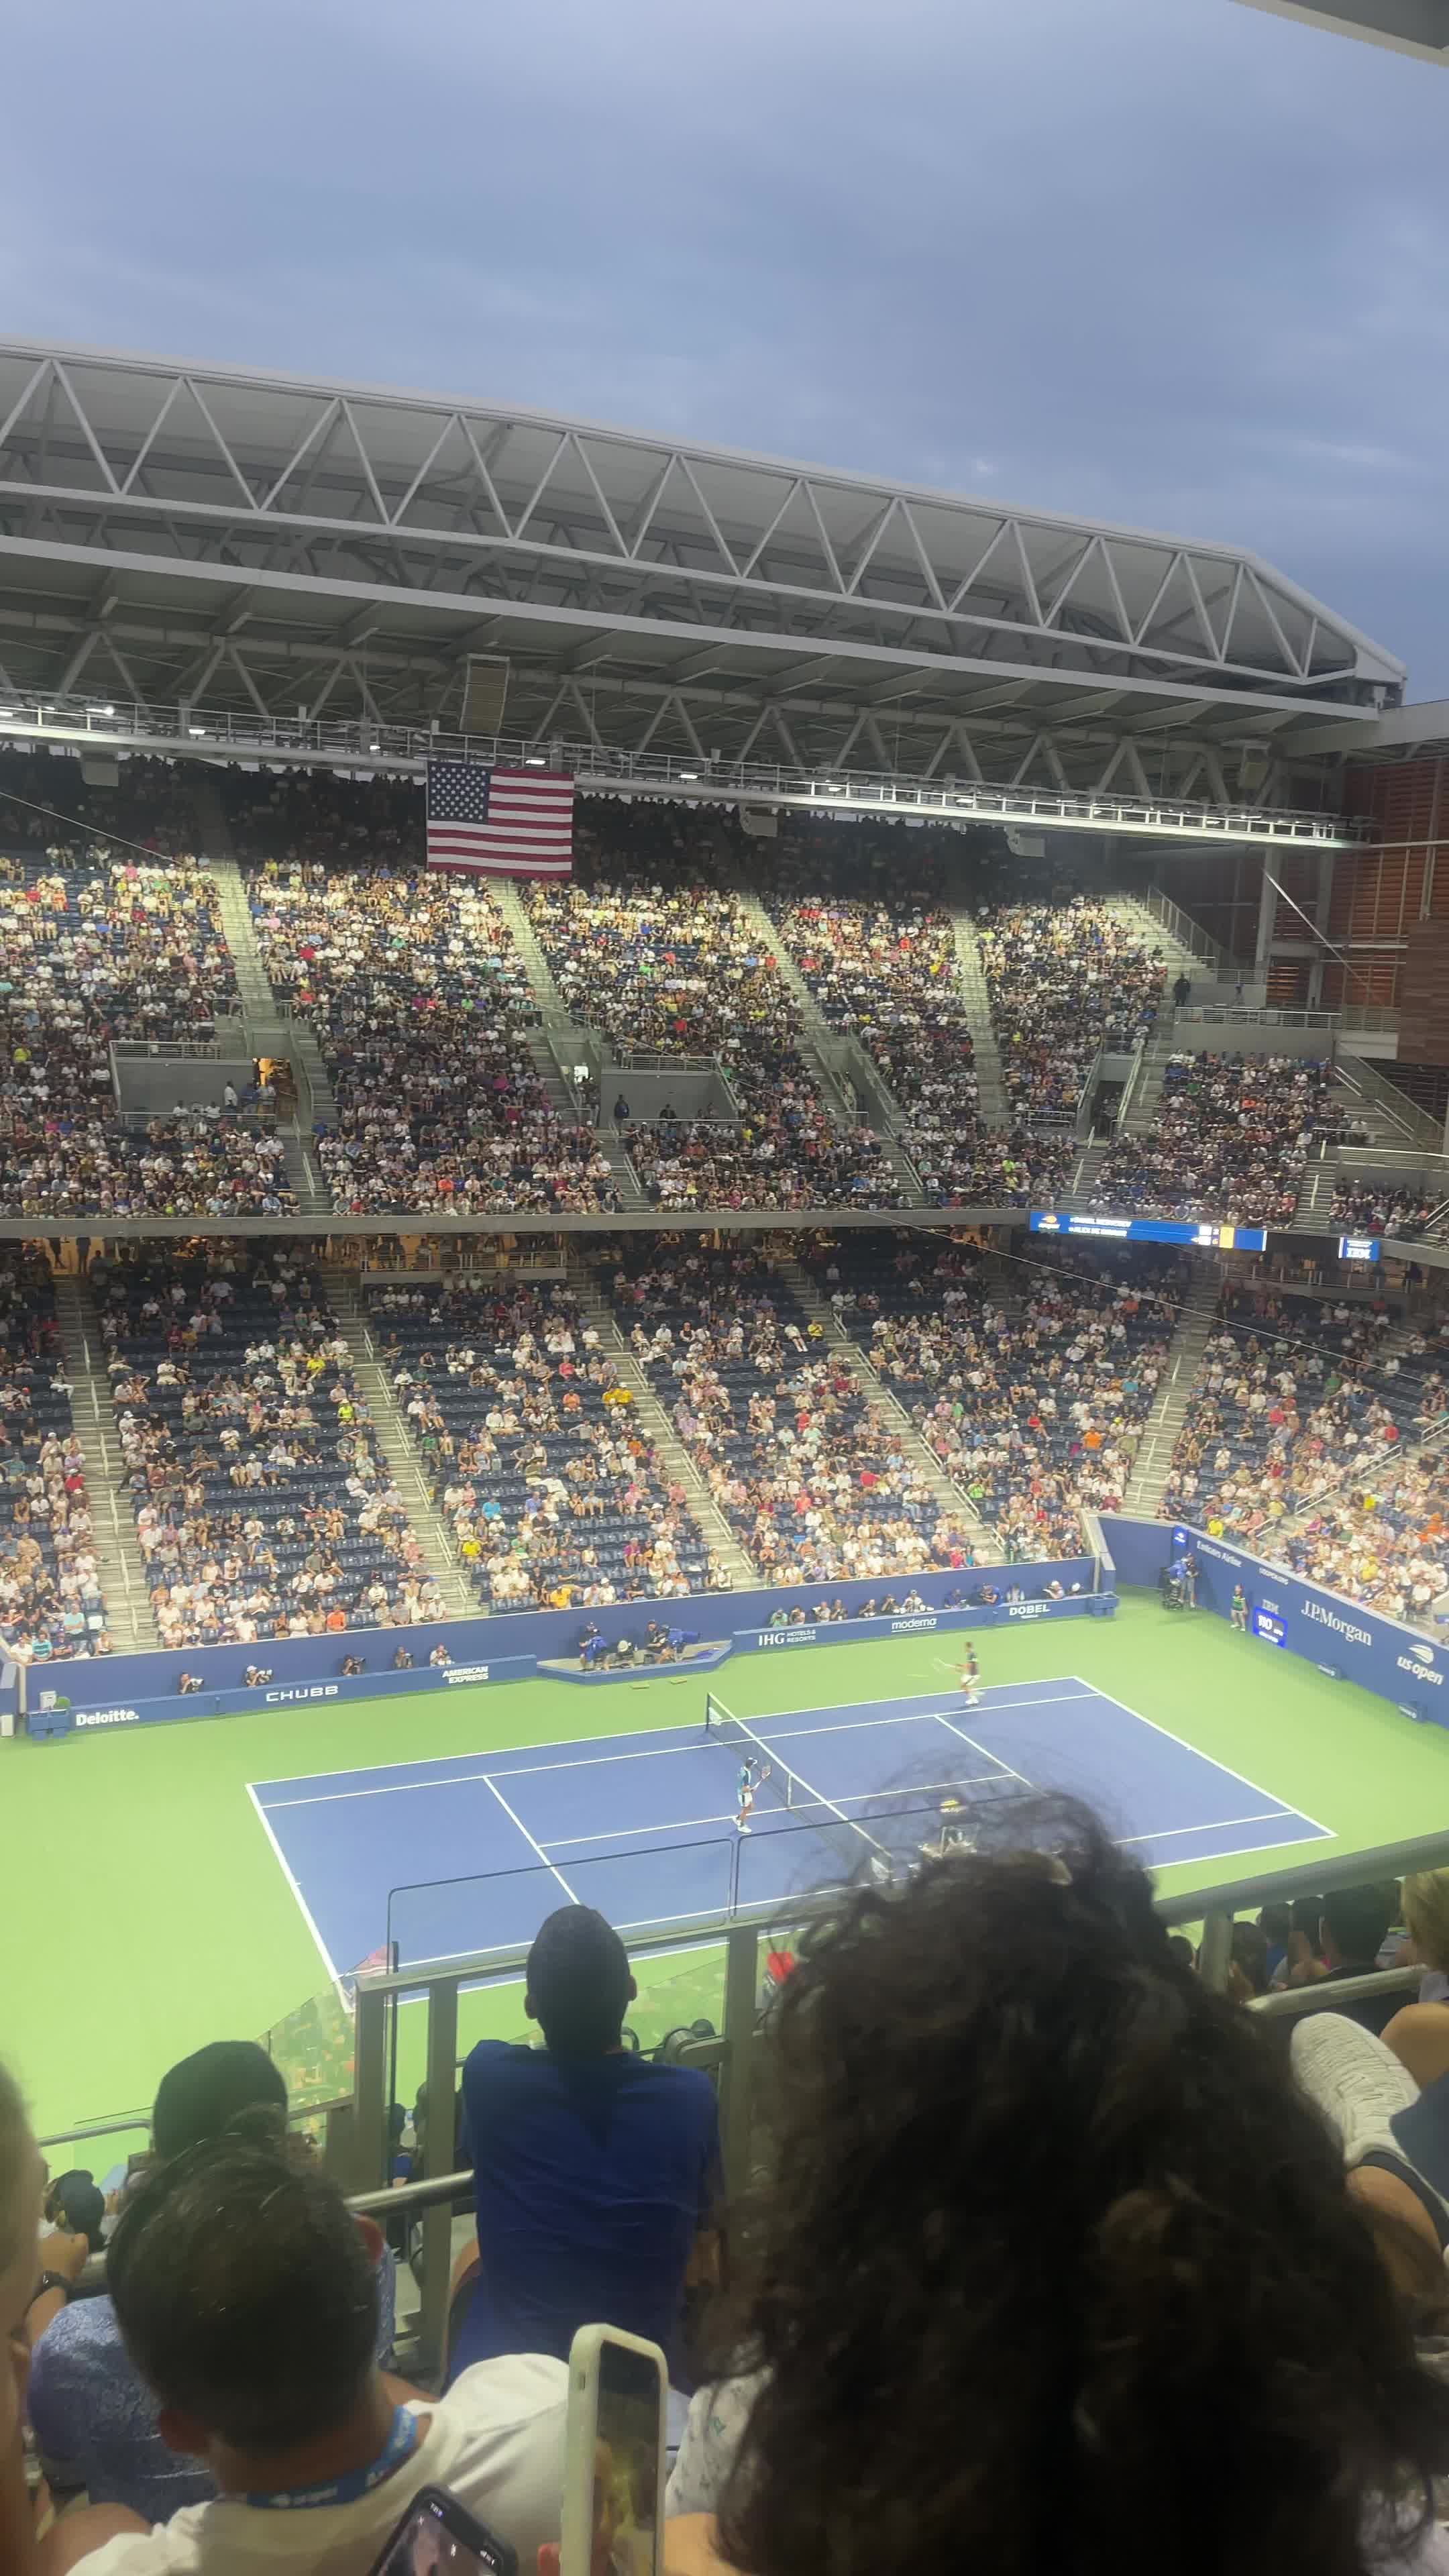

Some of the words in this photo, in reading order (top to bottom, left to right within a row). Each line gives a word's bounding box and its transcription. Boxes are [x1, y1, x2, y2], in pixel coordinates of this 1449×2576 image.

[1009, 1604, 1051, 1616] DOBEL
[892, 1618, 937, 1630] moderna
[759, 1632, 786, 1646] IHG
[266, 1685, 339, 1702] CHUBB
